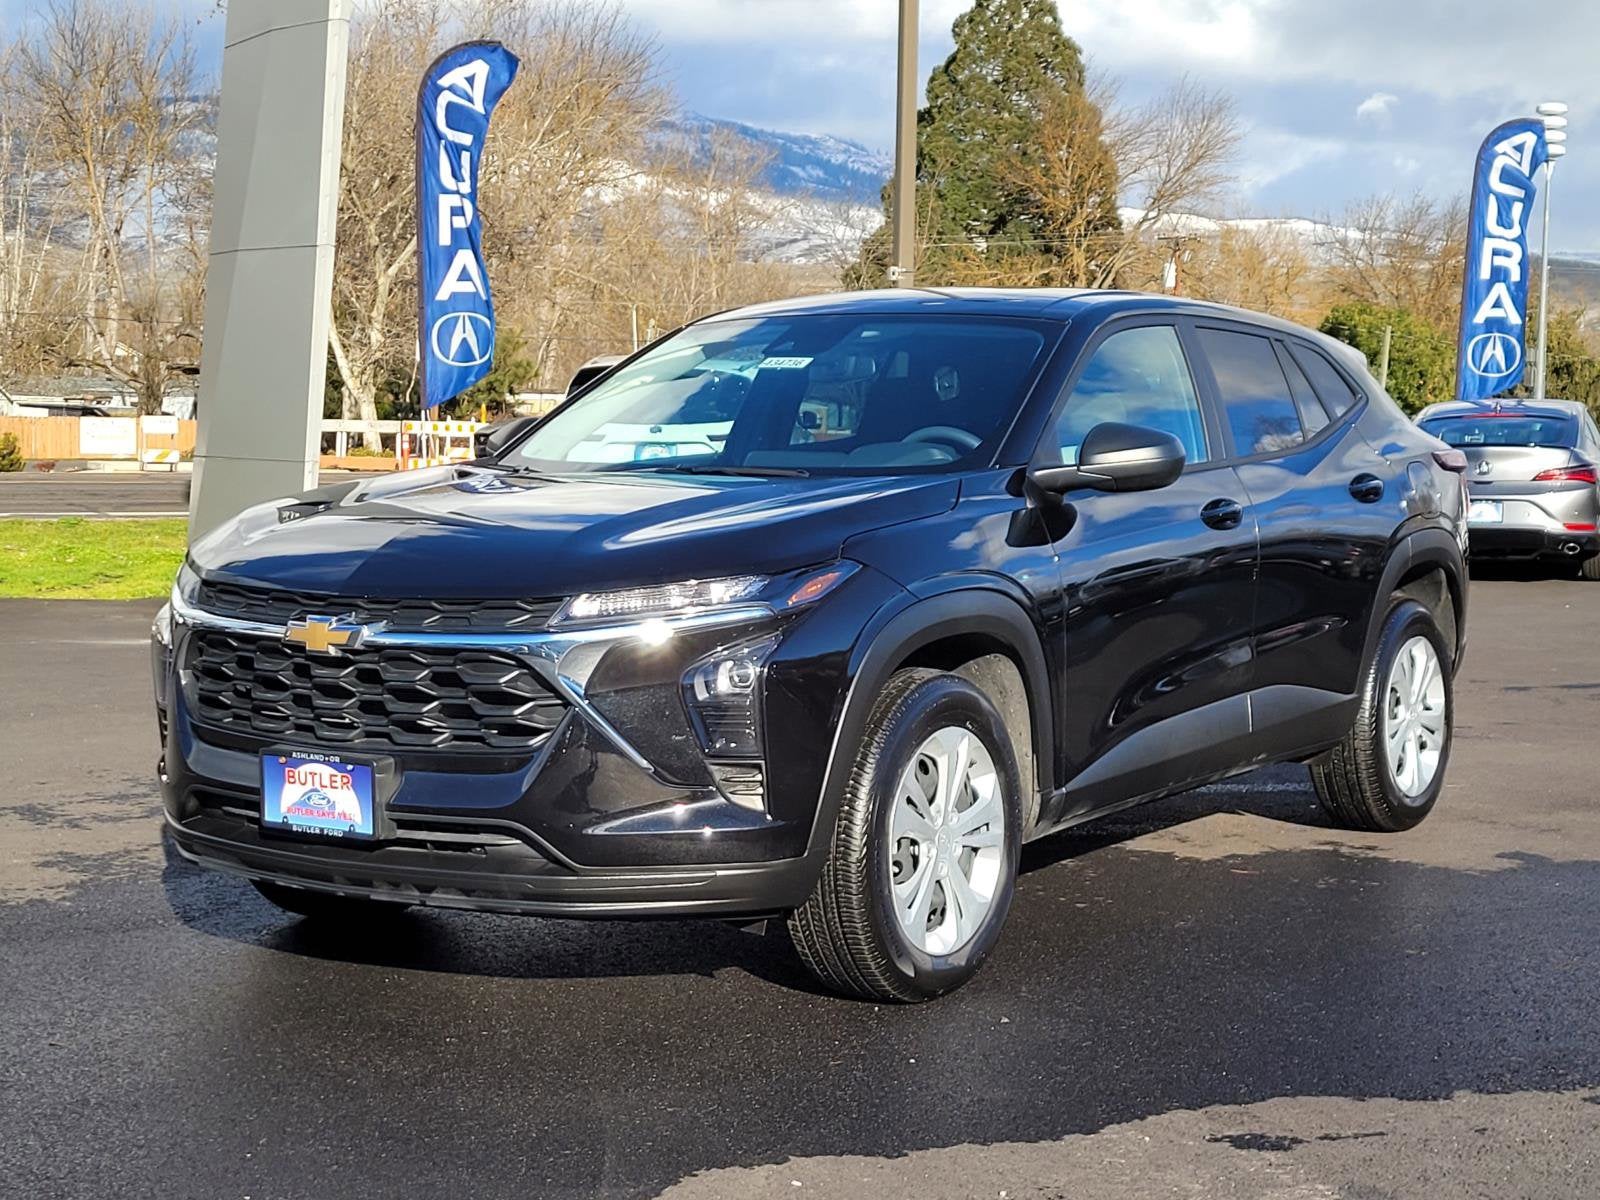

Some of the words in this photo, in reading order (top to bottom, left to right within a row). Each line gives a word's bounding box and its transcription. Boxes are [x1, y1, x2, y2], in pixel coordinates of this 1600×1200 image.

[1473, 130, 1538, 324] ACURA
[286, 769, 351, 790] BUTLER
[286, 805, 314, 817] BUTLER
[292, 825, 320, 834] BUTLER
[323, 828, 344, 837] FORD
